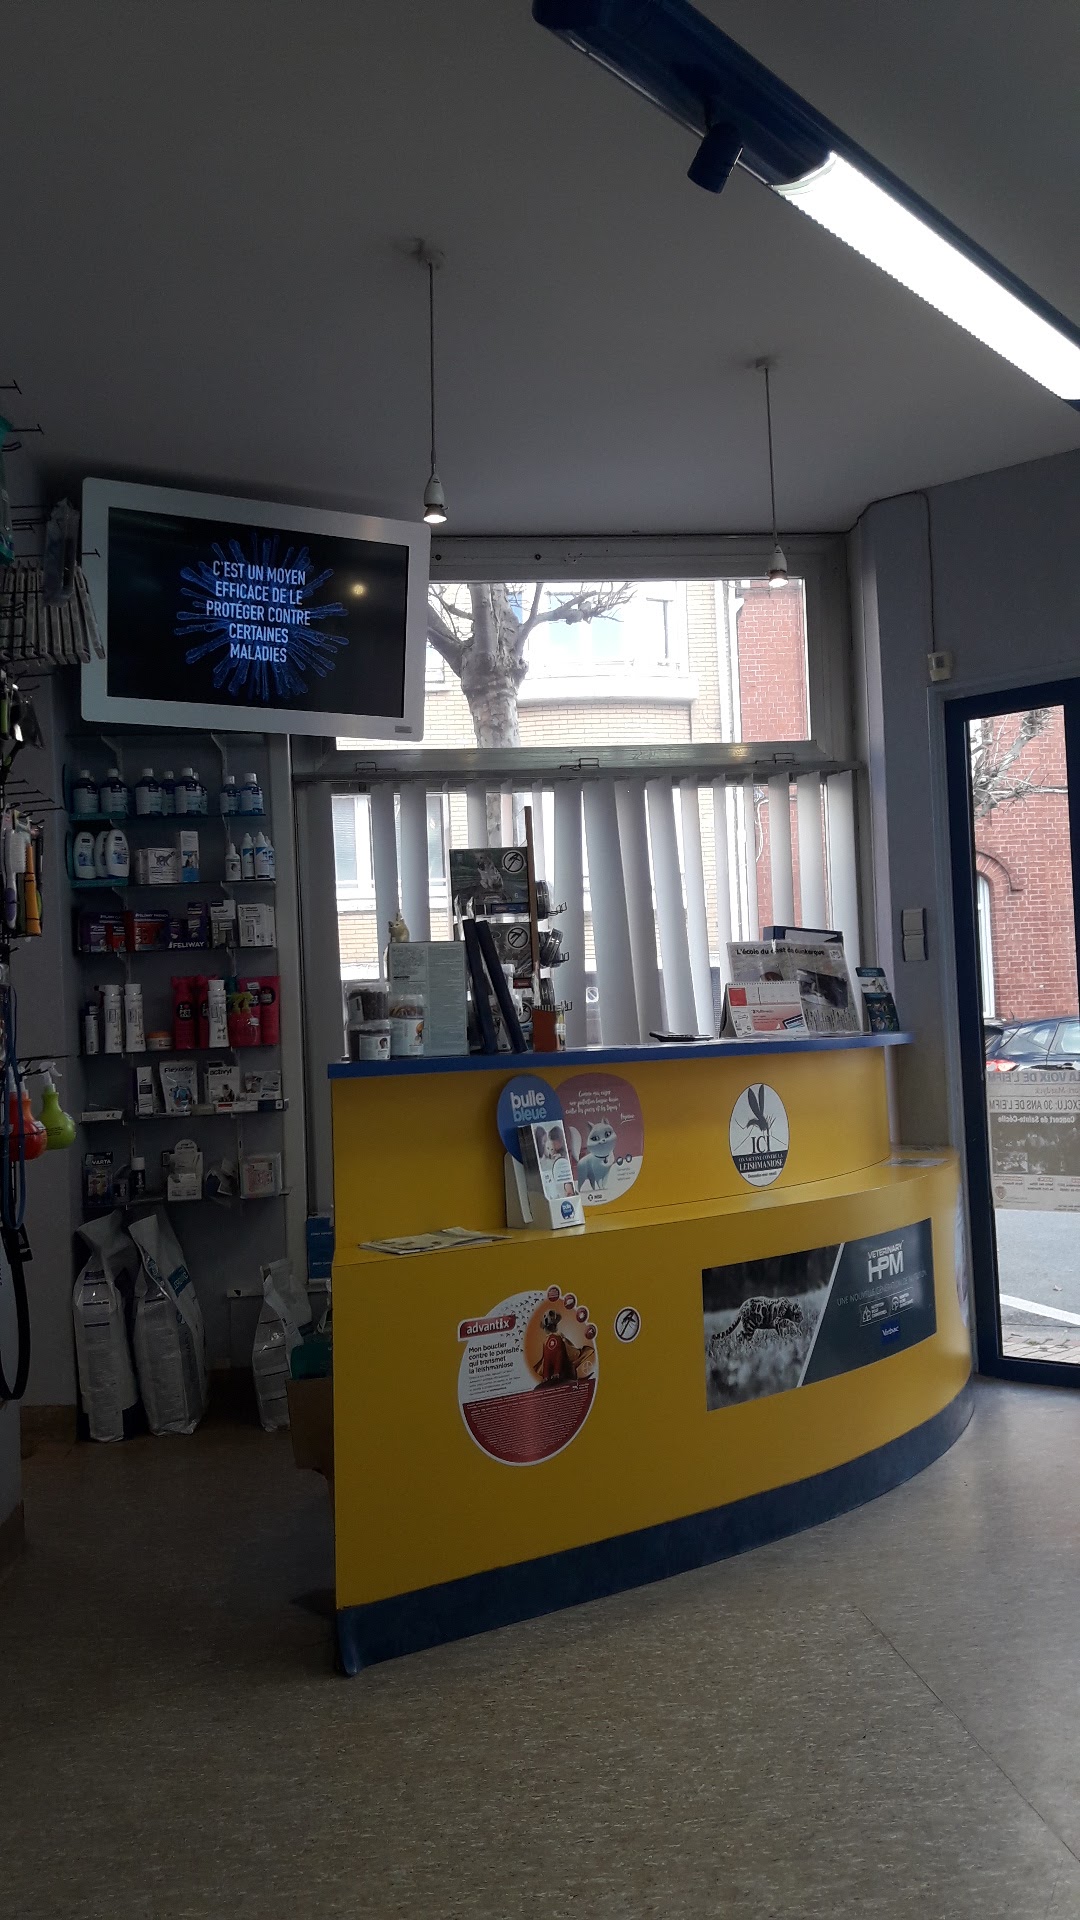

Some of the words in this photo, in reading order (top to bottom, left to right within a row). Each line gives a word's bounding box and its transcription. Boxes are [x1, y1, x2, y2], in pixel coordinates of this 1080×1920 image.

[213, 560, 245, 578] C'EST
[248, 564, 264, 582] UN
[267, 567, 306, 585] MOYEN
[215, 581, 269, 602] EFFICACE
[272, 588, 287, 604] DE
[289, 590, 303, 605] LE
[206, 600, 265, 621] PROTÉGER
[268, 607, 311, 626] CONTRE
[229, 623, 289, 644] CERTAINES
[230, 644, 287, 663] MALADIES
[173, 941, 205, 949] FELIWAY
[510, 1090, 546, 1109] bulle
[513, 1107, 547, 1122] bleue
[751, 1135, 771, 1153] ICI
[739, 1159, 784, 1171] LEISHMANIOSE
[868, 1251, 904, 1283] HPM
[466, 1318, 510, 1334] advantix
[483, 1342, 507, 1350] bouclier
[468, 1360, 479, 1368] qui
[480, 1356, 506, 1364] transmet
[475, 1362, 514, 1373] leishmaniose
